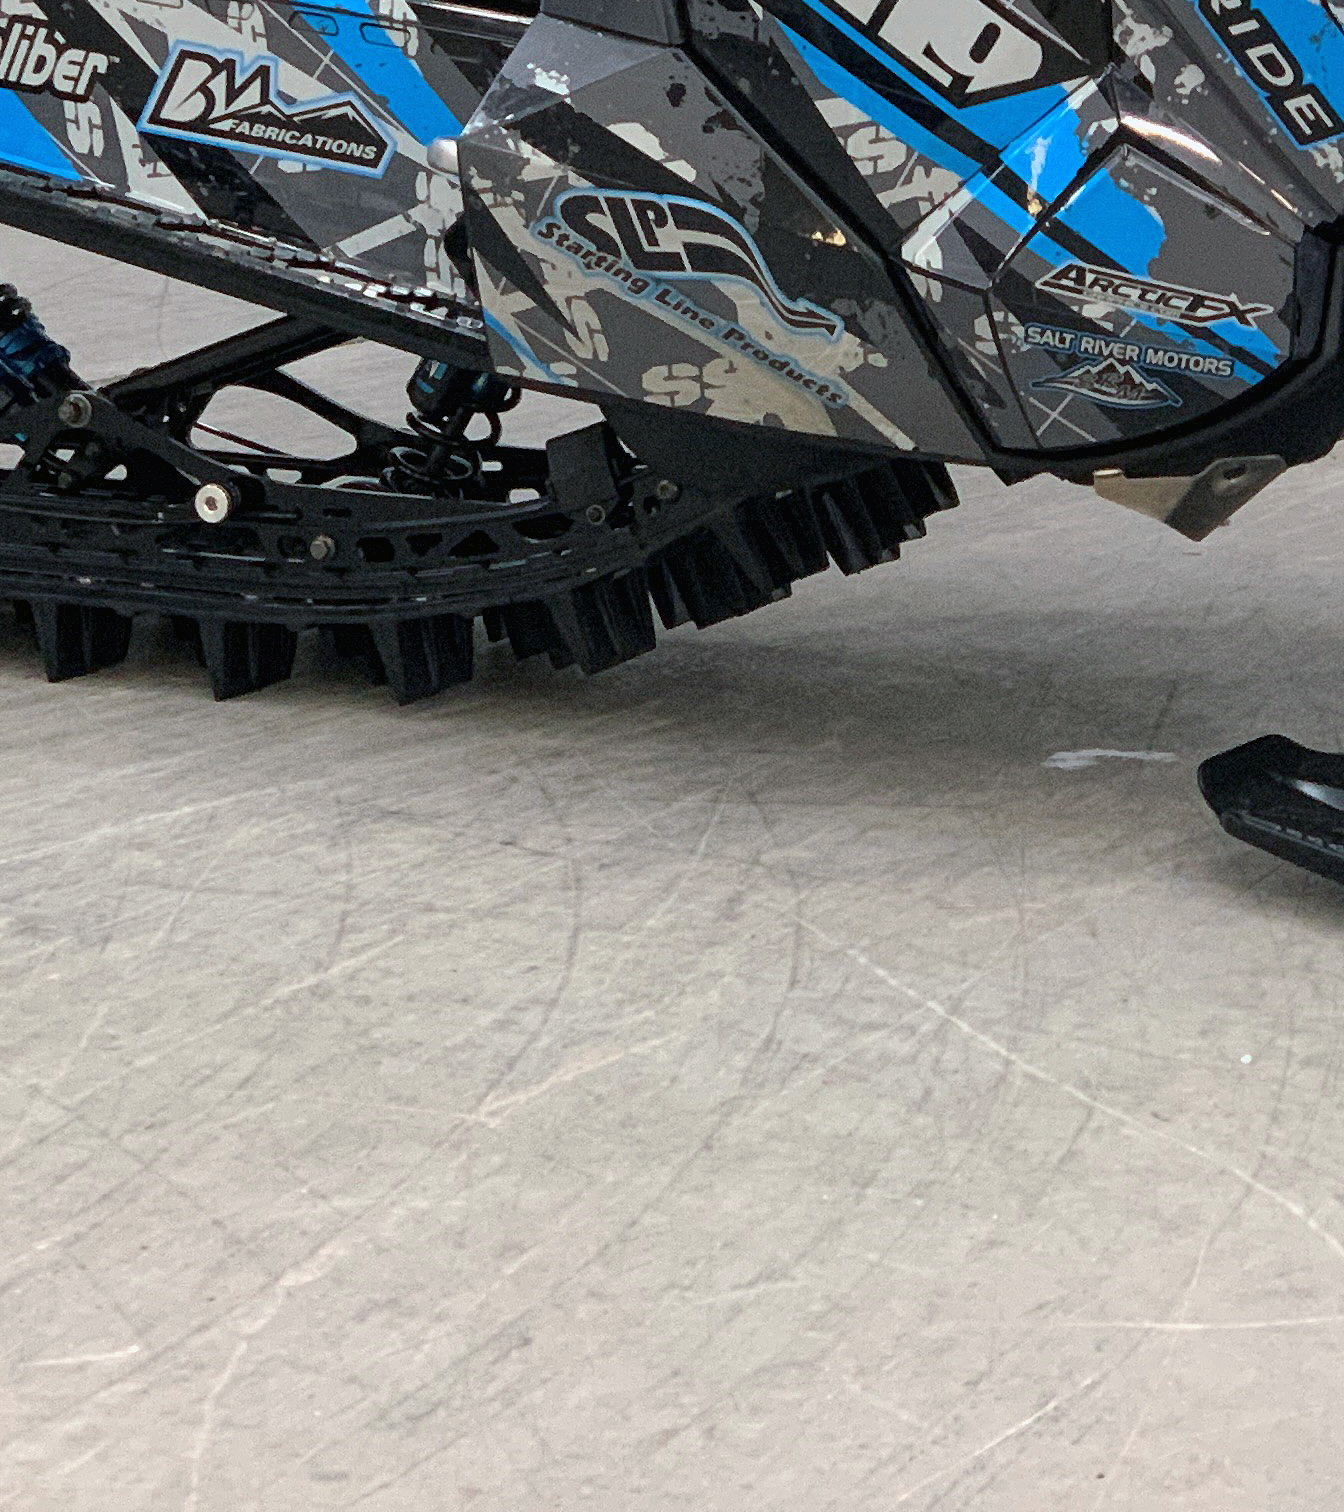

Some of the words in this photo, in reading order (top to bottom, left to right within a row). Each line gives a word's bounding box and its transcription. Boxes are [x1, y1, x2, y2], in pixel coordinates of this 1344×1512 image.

[228, 119, 377, 160] FABRICATIONS
[537, 222, 651, 294] Starting
[654, 287, 716, 330] Line
[723, 327, 844, 403] Products
[1027, 326, 1075, 350] SALT
[1080, 336, 1141, 362] RIVER
[1145, 348, 1233, 377] MOTORS
